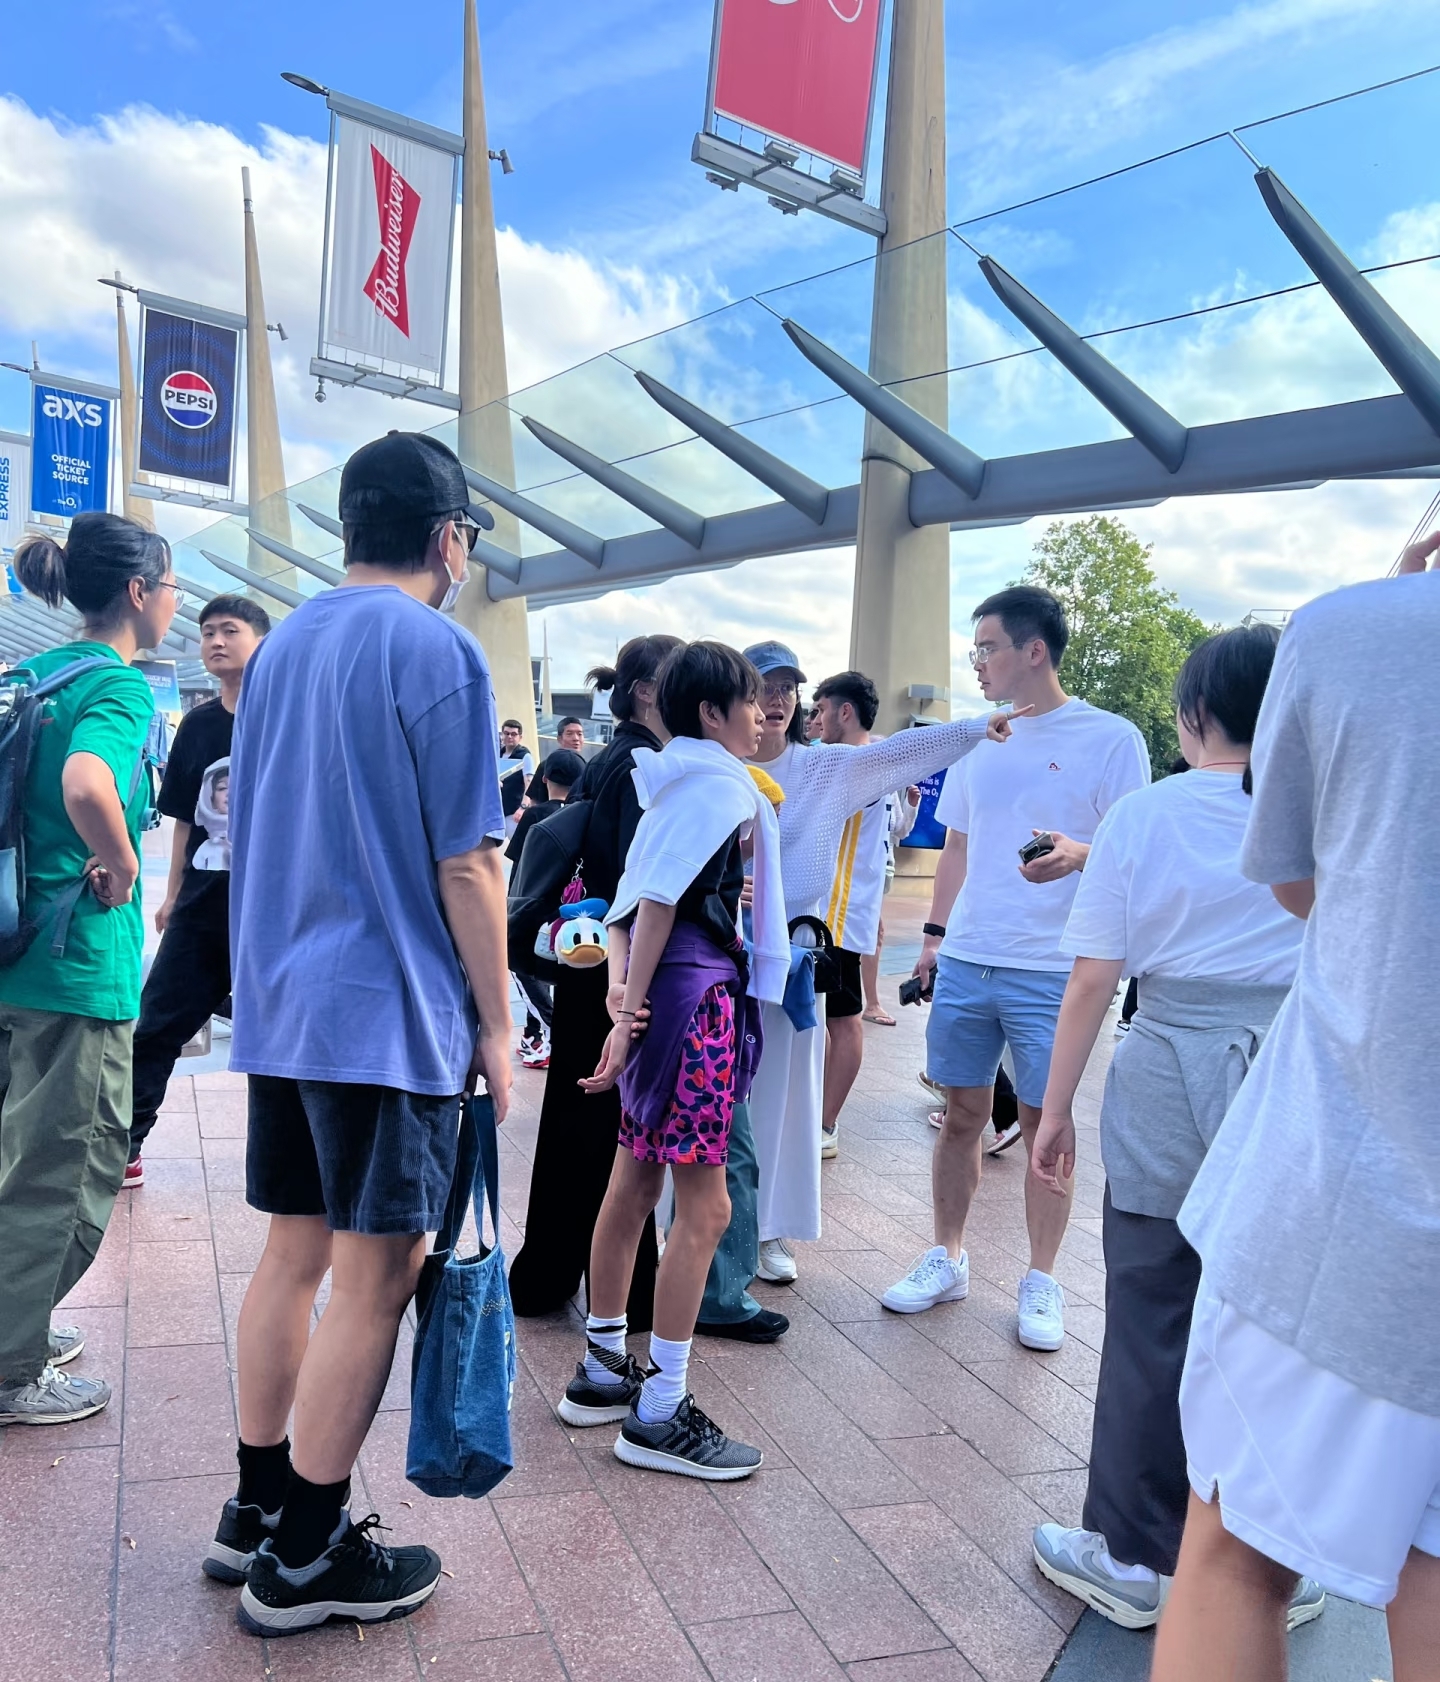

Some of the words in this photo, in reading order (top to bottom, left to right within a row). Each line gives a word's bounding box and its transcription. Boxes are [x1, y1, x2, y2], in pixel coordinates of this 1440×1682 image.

[374, 169, 405, 318] Budweiser
[165, 389, 213, 410] PEPSI
[51, 453, 91, 469] OFFICIAL
[56, 463, 87, 476] TICKET
[52, 470, 89, 485] SOURCE
[934, 777, 939, 785] is
[920, 787, 930, 795] The
